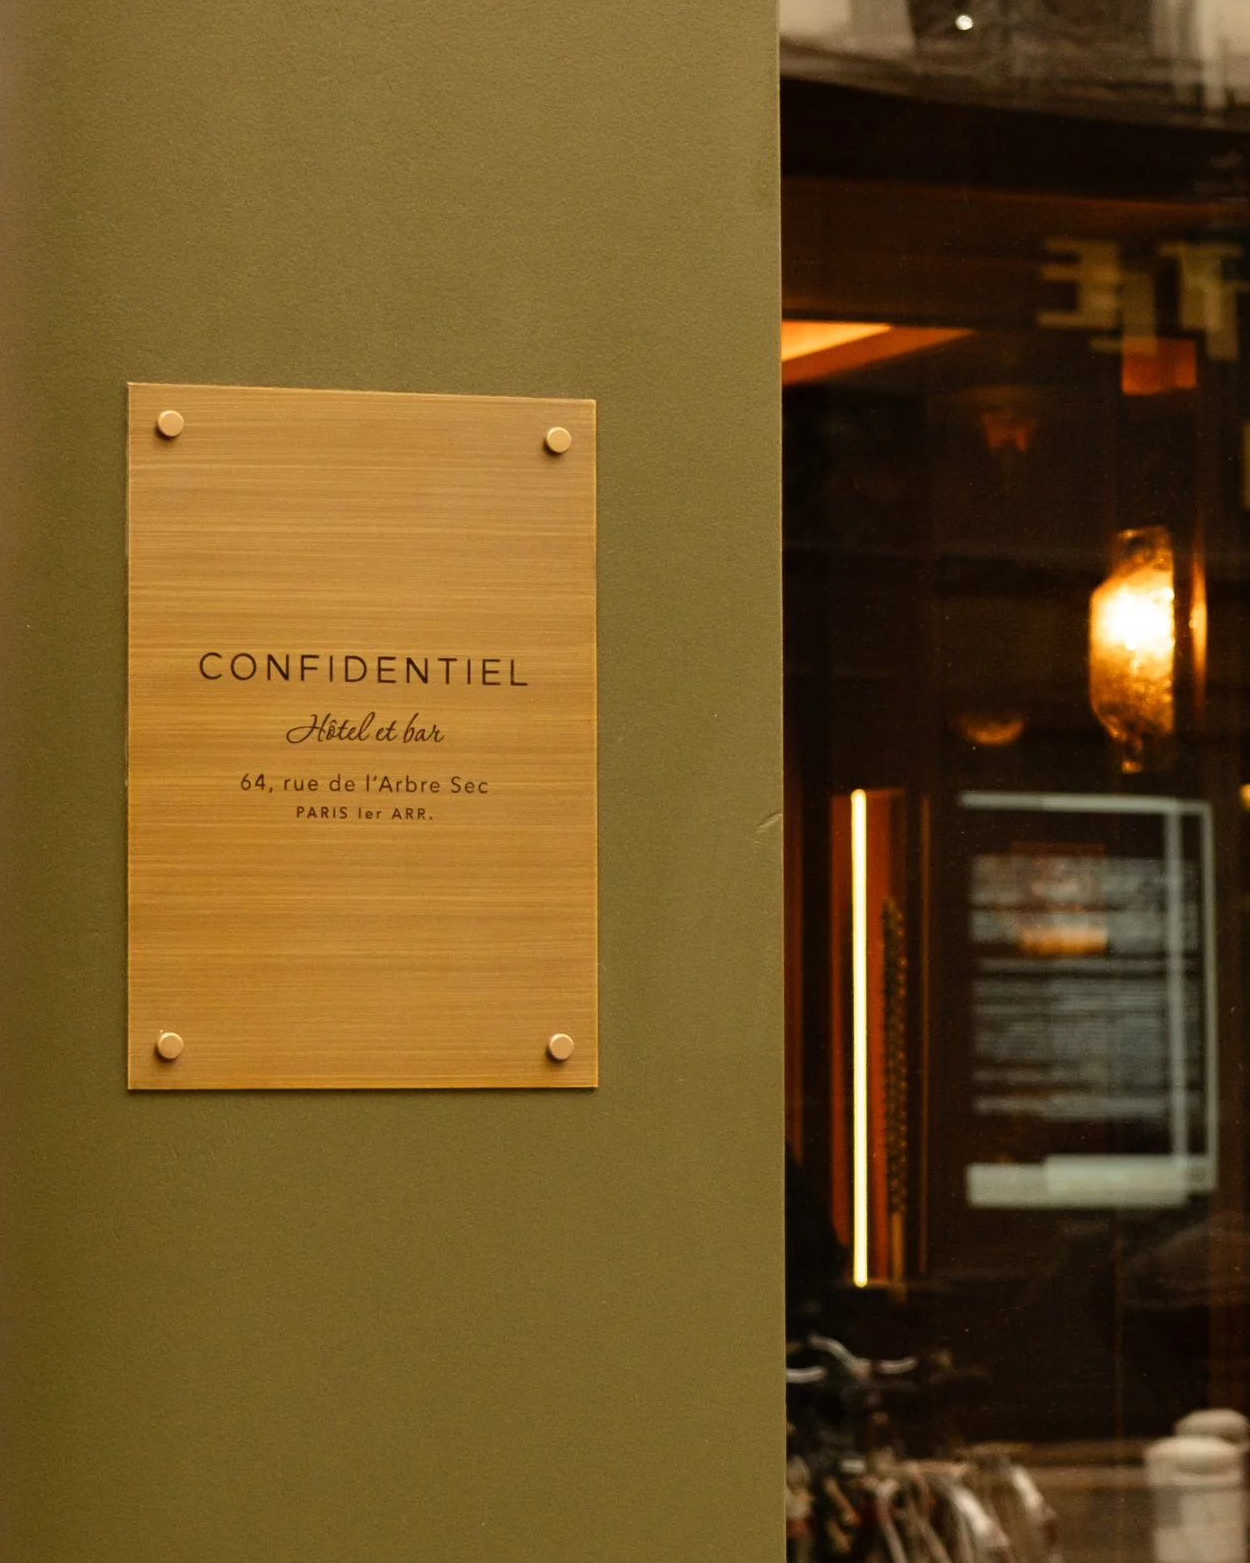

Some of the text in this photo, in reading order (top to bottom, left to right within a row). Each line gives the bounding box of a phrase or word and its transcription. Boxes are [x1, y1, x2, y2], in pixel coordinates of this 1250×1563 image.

[198, 651, 529, 687] CONFIDENTIEL
[285, 711, 445, 744] Hôtel et bar
[240, 773, 489, 795] 64, rue de l'Arbre Sec
[296, 805, 348, 820] PARIS
[390, 807, 434, 821] ARR.
